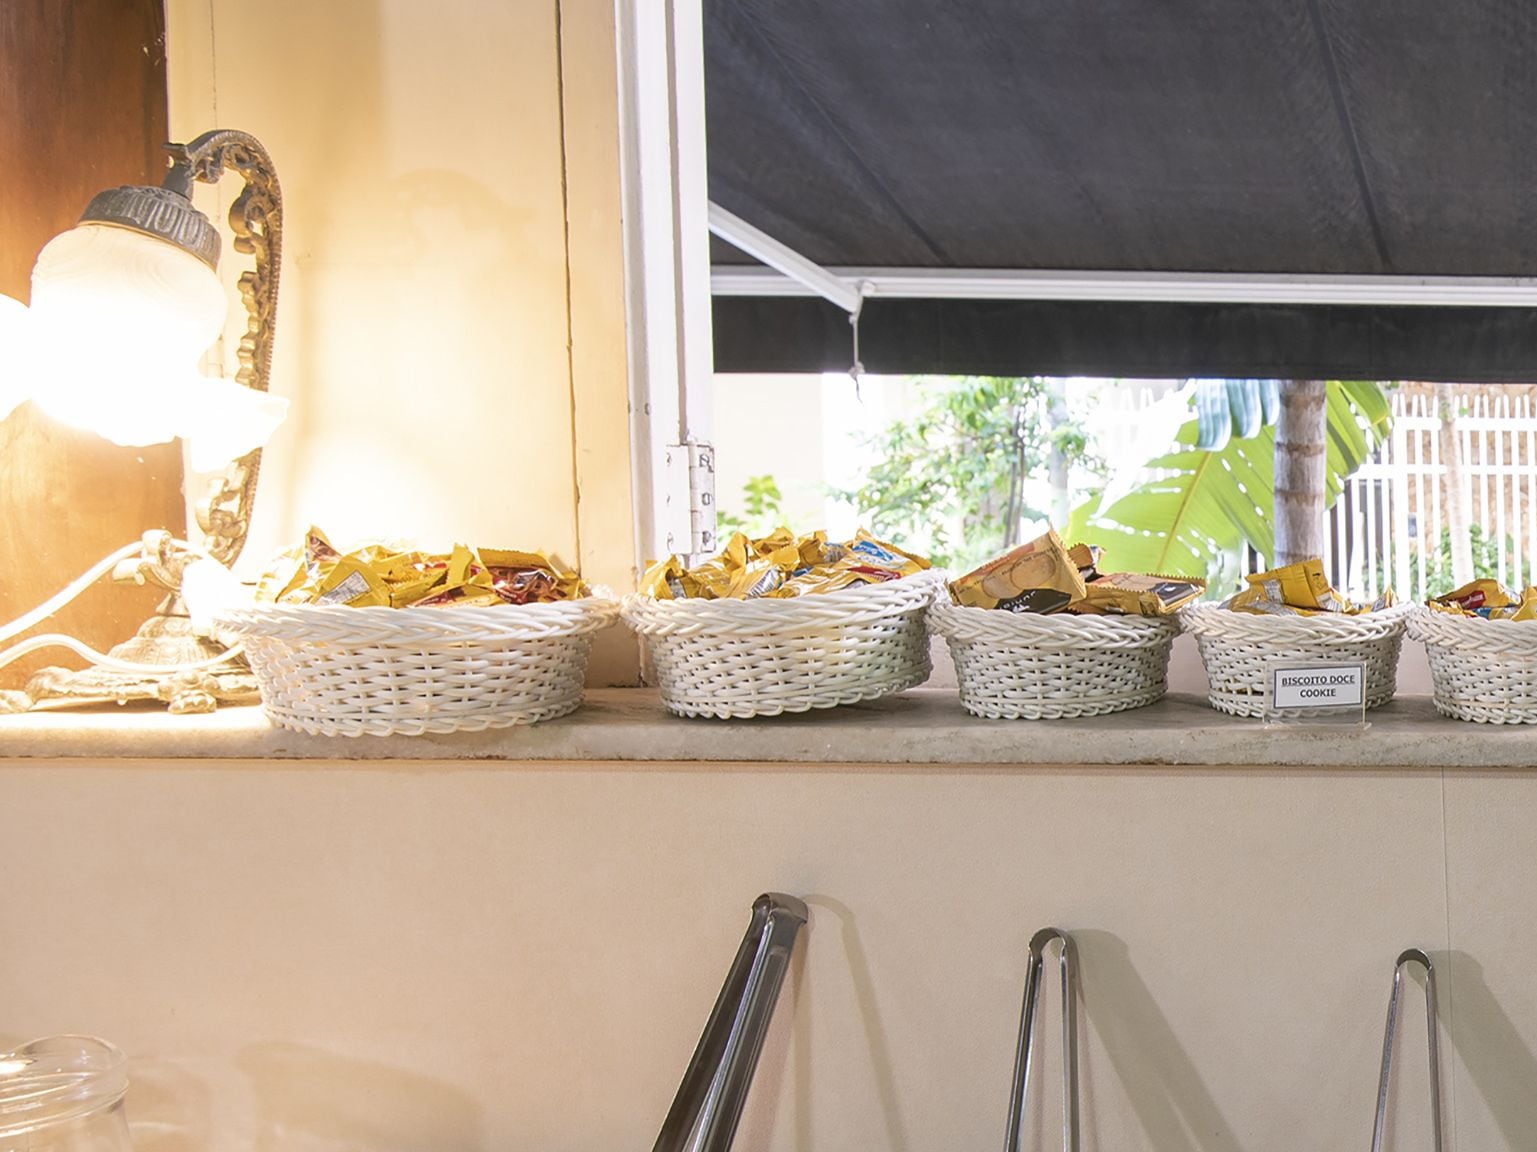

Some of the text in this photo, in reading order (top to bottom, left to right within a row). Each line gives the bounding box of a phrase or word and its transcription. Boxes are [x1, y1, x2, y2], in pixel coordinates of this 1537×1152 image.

[1282, 674, 1355, 686] BISCOITO DOCE
[1300, 689, 1336, 698] COOKIE
